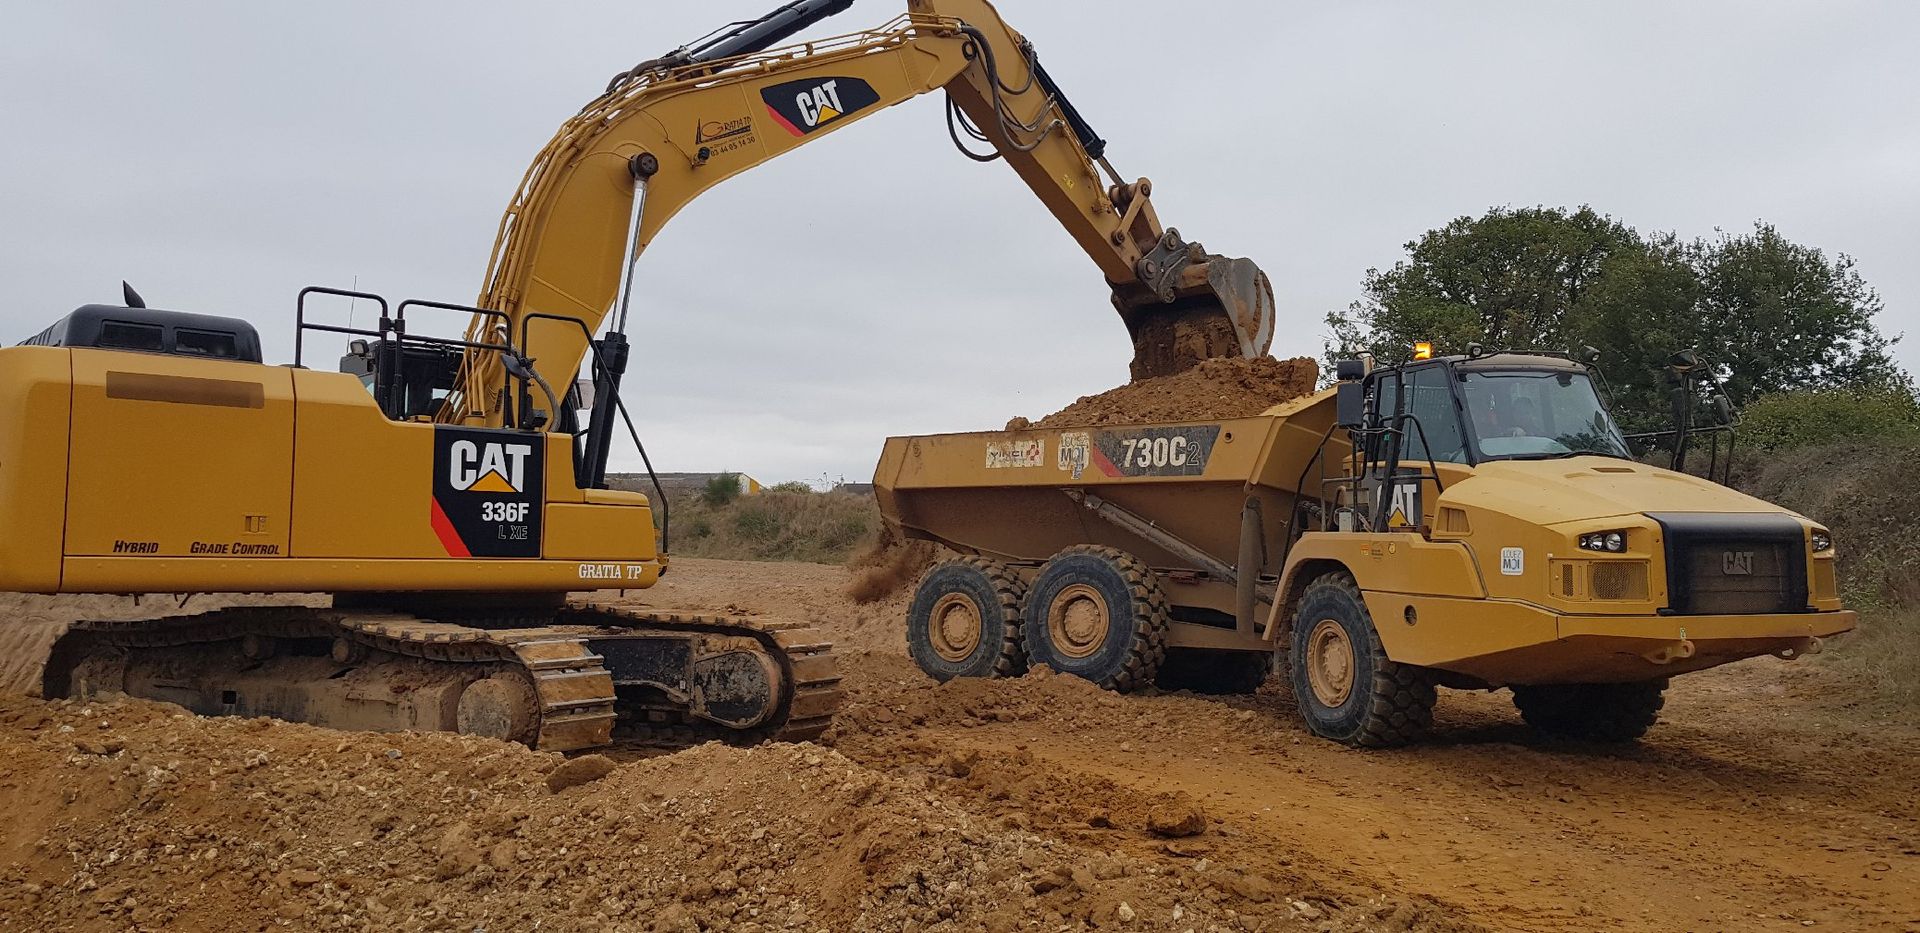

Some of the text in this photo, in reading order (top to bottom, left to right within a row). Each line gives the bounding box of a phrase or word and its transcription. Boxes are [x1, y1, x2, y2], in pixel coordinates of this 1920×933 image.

[796, 80, 843, 127] CAT
[450, 440, 531, 492] CAT
[482, 502, 529, 522] 336F
[498, 525, 528, 540] L XE
[112, 540, 159, 553] HYBRID
[190, 541, 280, 555] GRADE CONTROL
[578, 564, 642, 580] GRATIA TP
[1722, 551, 1754, 575] CAT
